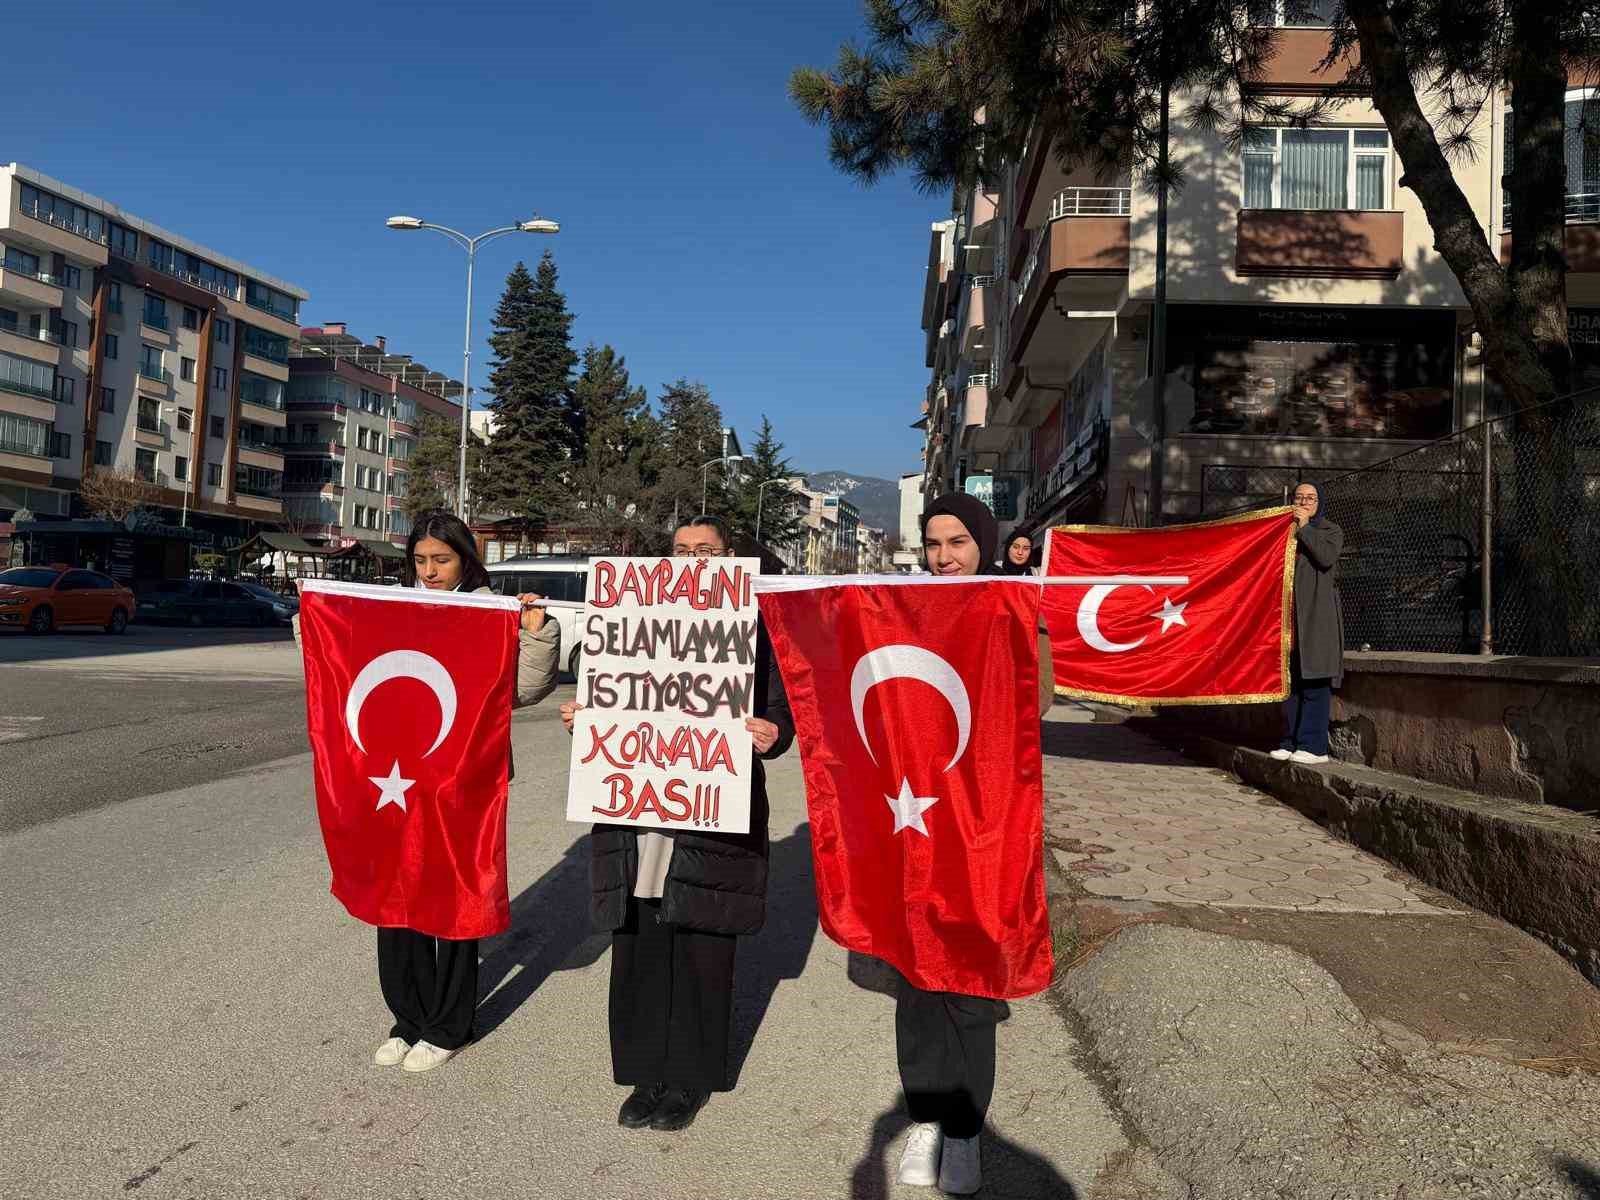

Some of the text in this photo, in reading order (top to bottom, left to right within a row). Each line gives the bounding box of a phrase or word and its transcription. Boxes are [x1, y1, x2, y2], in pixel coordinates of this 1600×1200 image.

[590, 558, 751, 611] BAYRAĞINI
[583, 614, 758, 665] SELAMLAMAK
[581, 721, 738, 777] KORNAYA
[592, 773, 721, 828] BAS!!!
